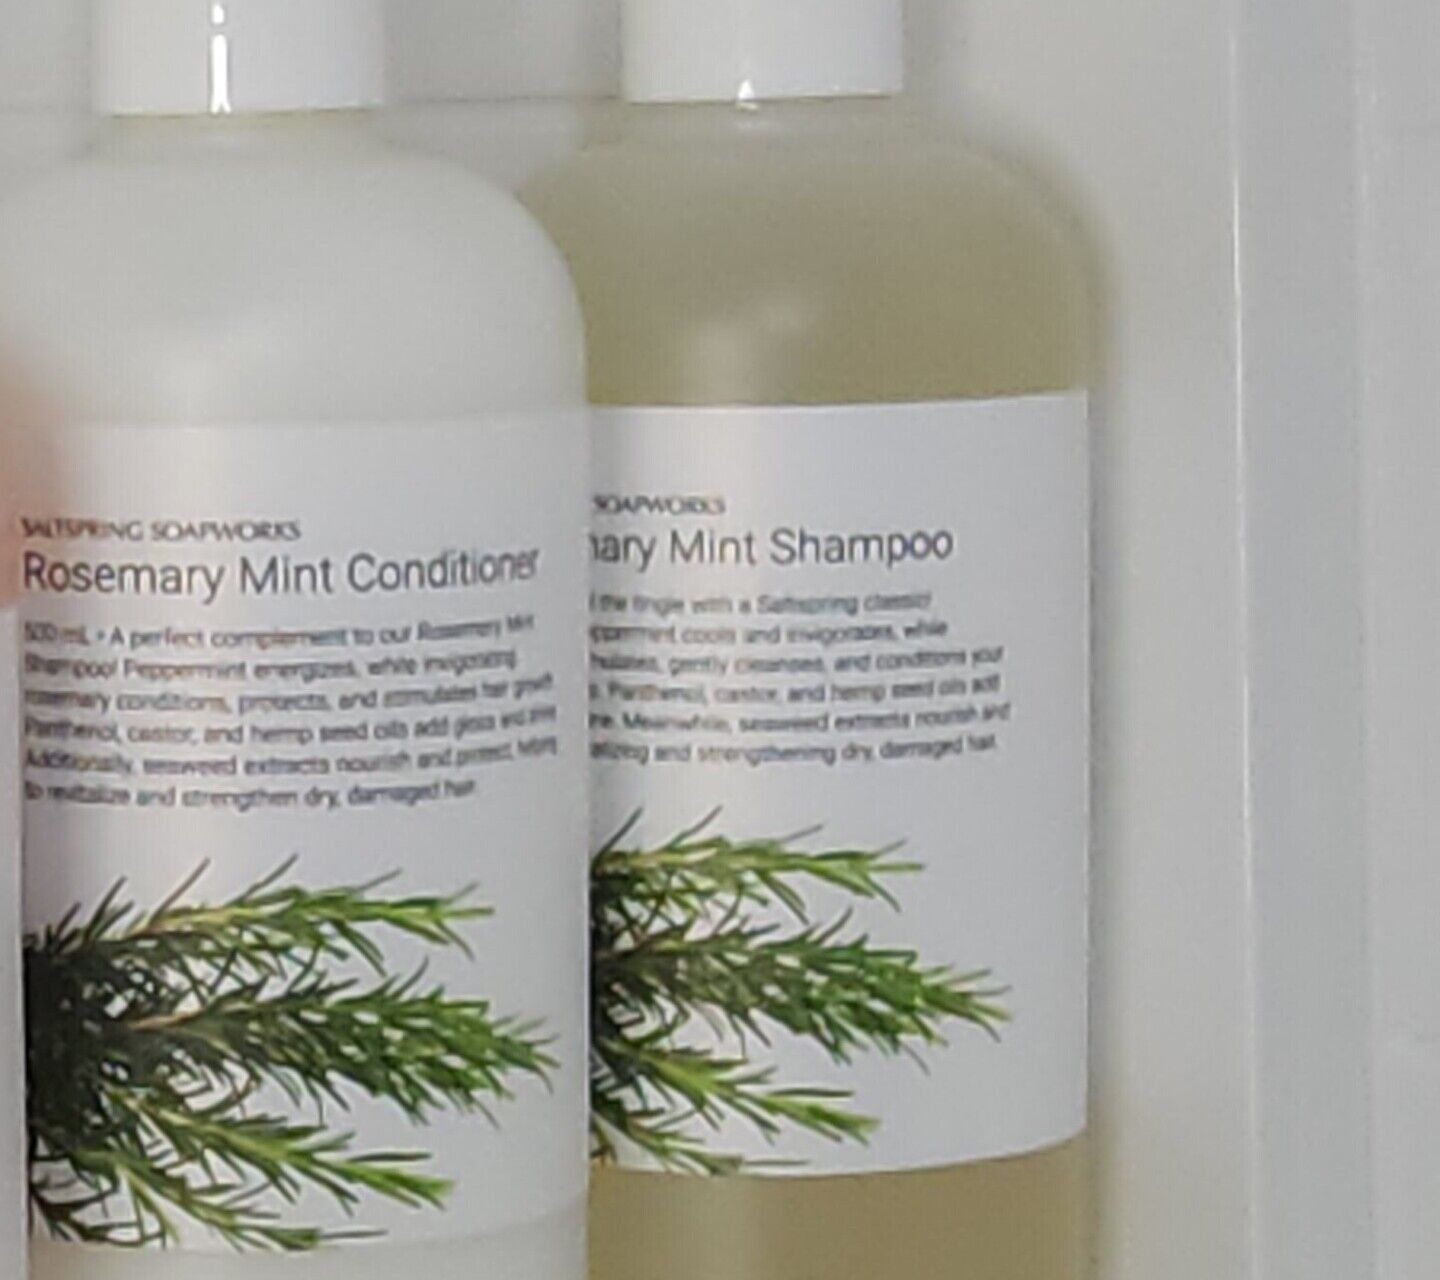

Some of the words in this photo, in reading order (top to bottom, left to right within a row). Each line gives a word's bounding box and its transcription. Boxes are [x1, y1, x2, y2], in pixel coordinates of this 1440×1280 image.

[151, 520, 301, 542] SOAPWORKS
[671, 527, 757, 566] Mint
[769, 527, 954, 570] Shampoo
[24, 550, 225, 605] Rosemary
[240, 554, 334, 595] Mint
[347, 548, 540, 593] Conditioner
[111, 625, 125, 644] A
[130, 626, 204, 650] perfect
[353, 628, 375, 646] to
[379, 626, 411, 645] our
[745, 627, 781, 644] and
[123, 658, 246, 681] Peppermint
[835, 655, 871, 671] and
[338, 691, 377, 709] and
[788, 685, 825, 702] and
[204, 726, 243, 744] and
[250, 725, 312, 745] hemp
[417, 748, 452, 769] and
[654, 744, 692, 761] and
[136, 786, 176, 805] and
